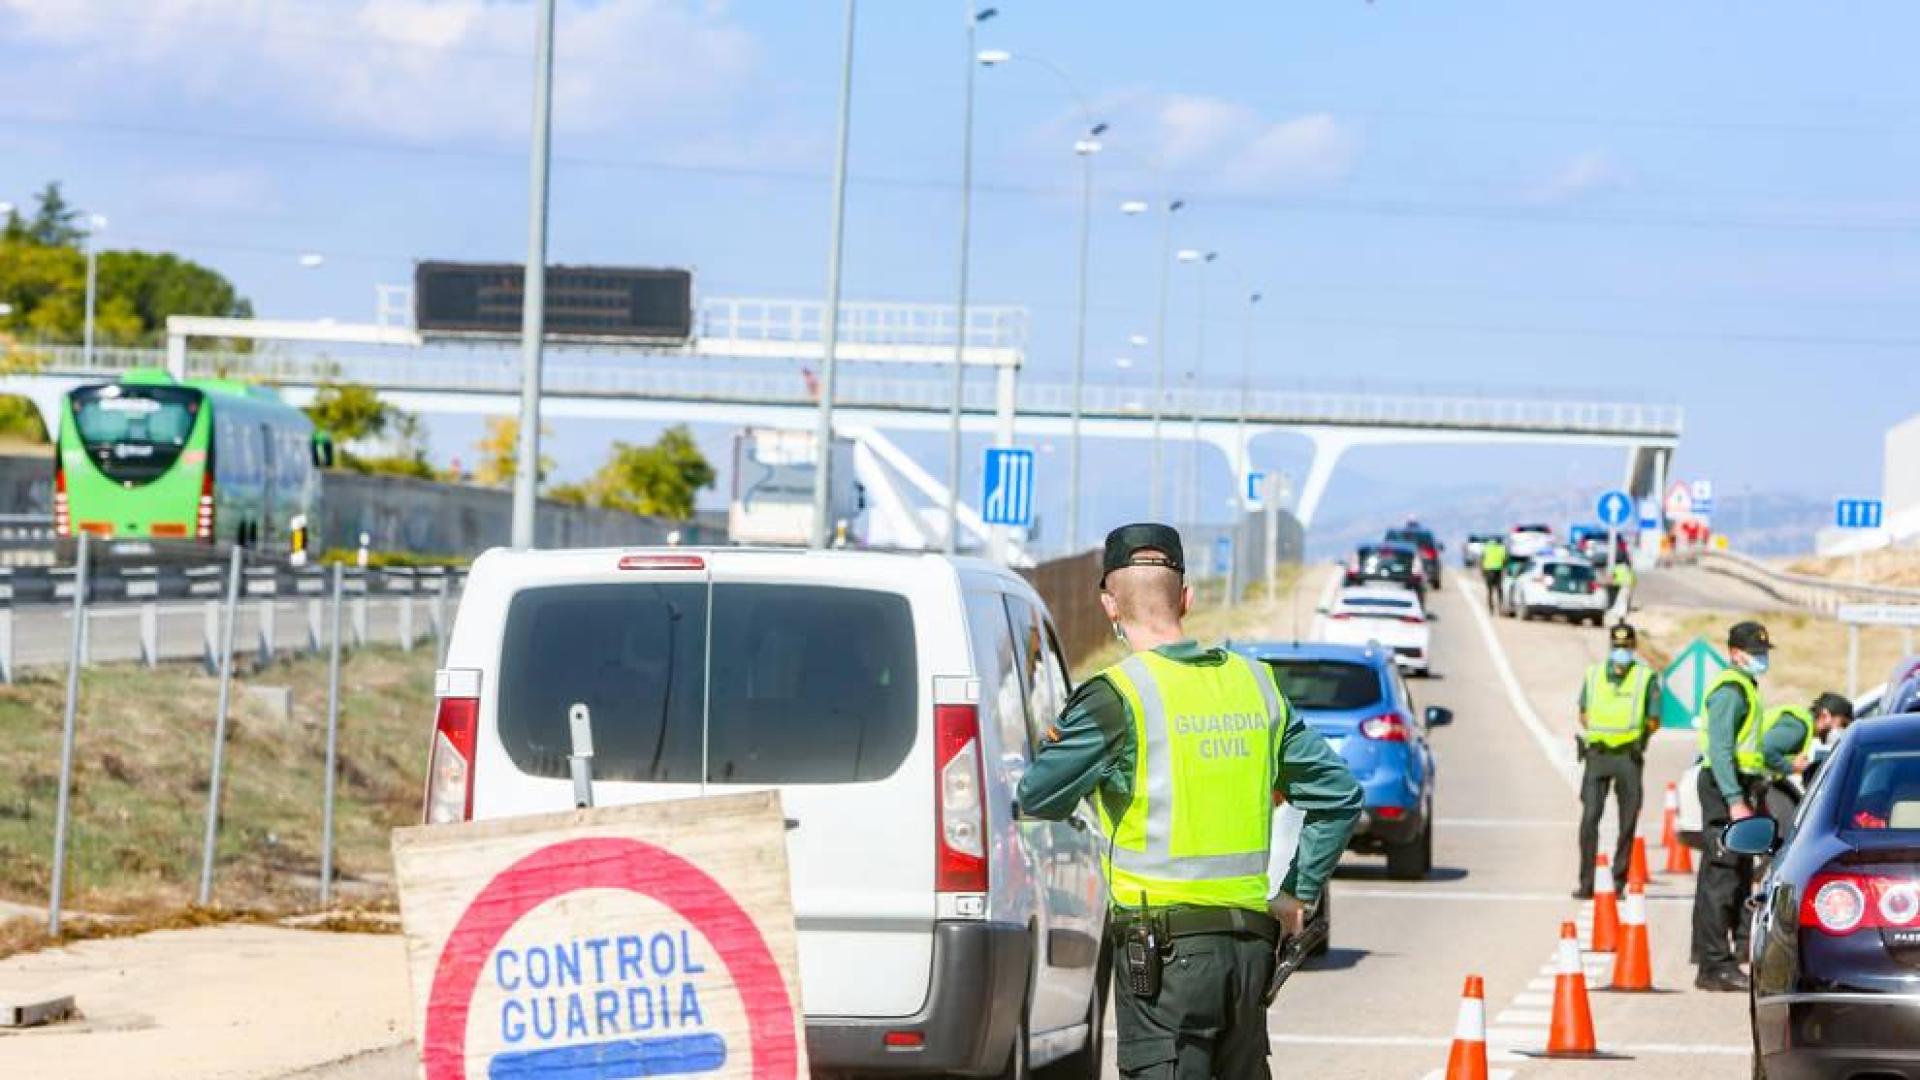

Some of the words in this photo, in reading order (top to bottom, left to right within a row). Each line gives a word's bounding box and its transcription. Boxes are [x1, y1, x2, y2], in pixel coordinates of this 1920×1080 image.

[1175, 713, 1265, 734] GUARDIA
[1200, 737, 1250, 758] CIVIL
[496, 930, 705, 991] CONTROL
[502, 982, 703, 1042] GUARDIA
